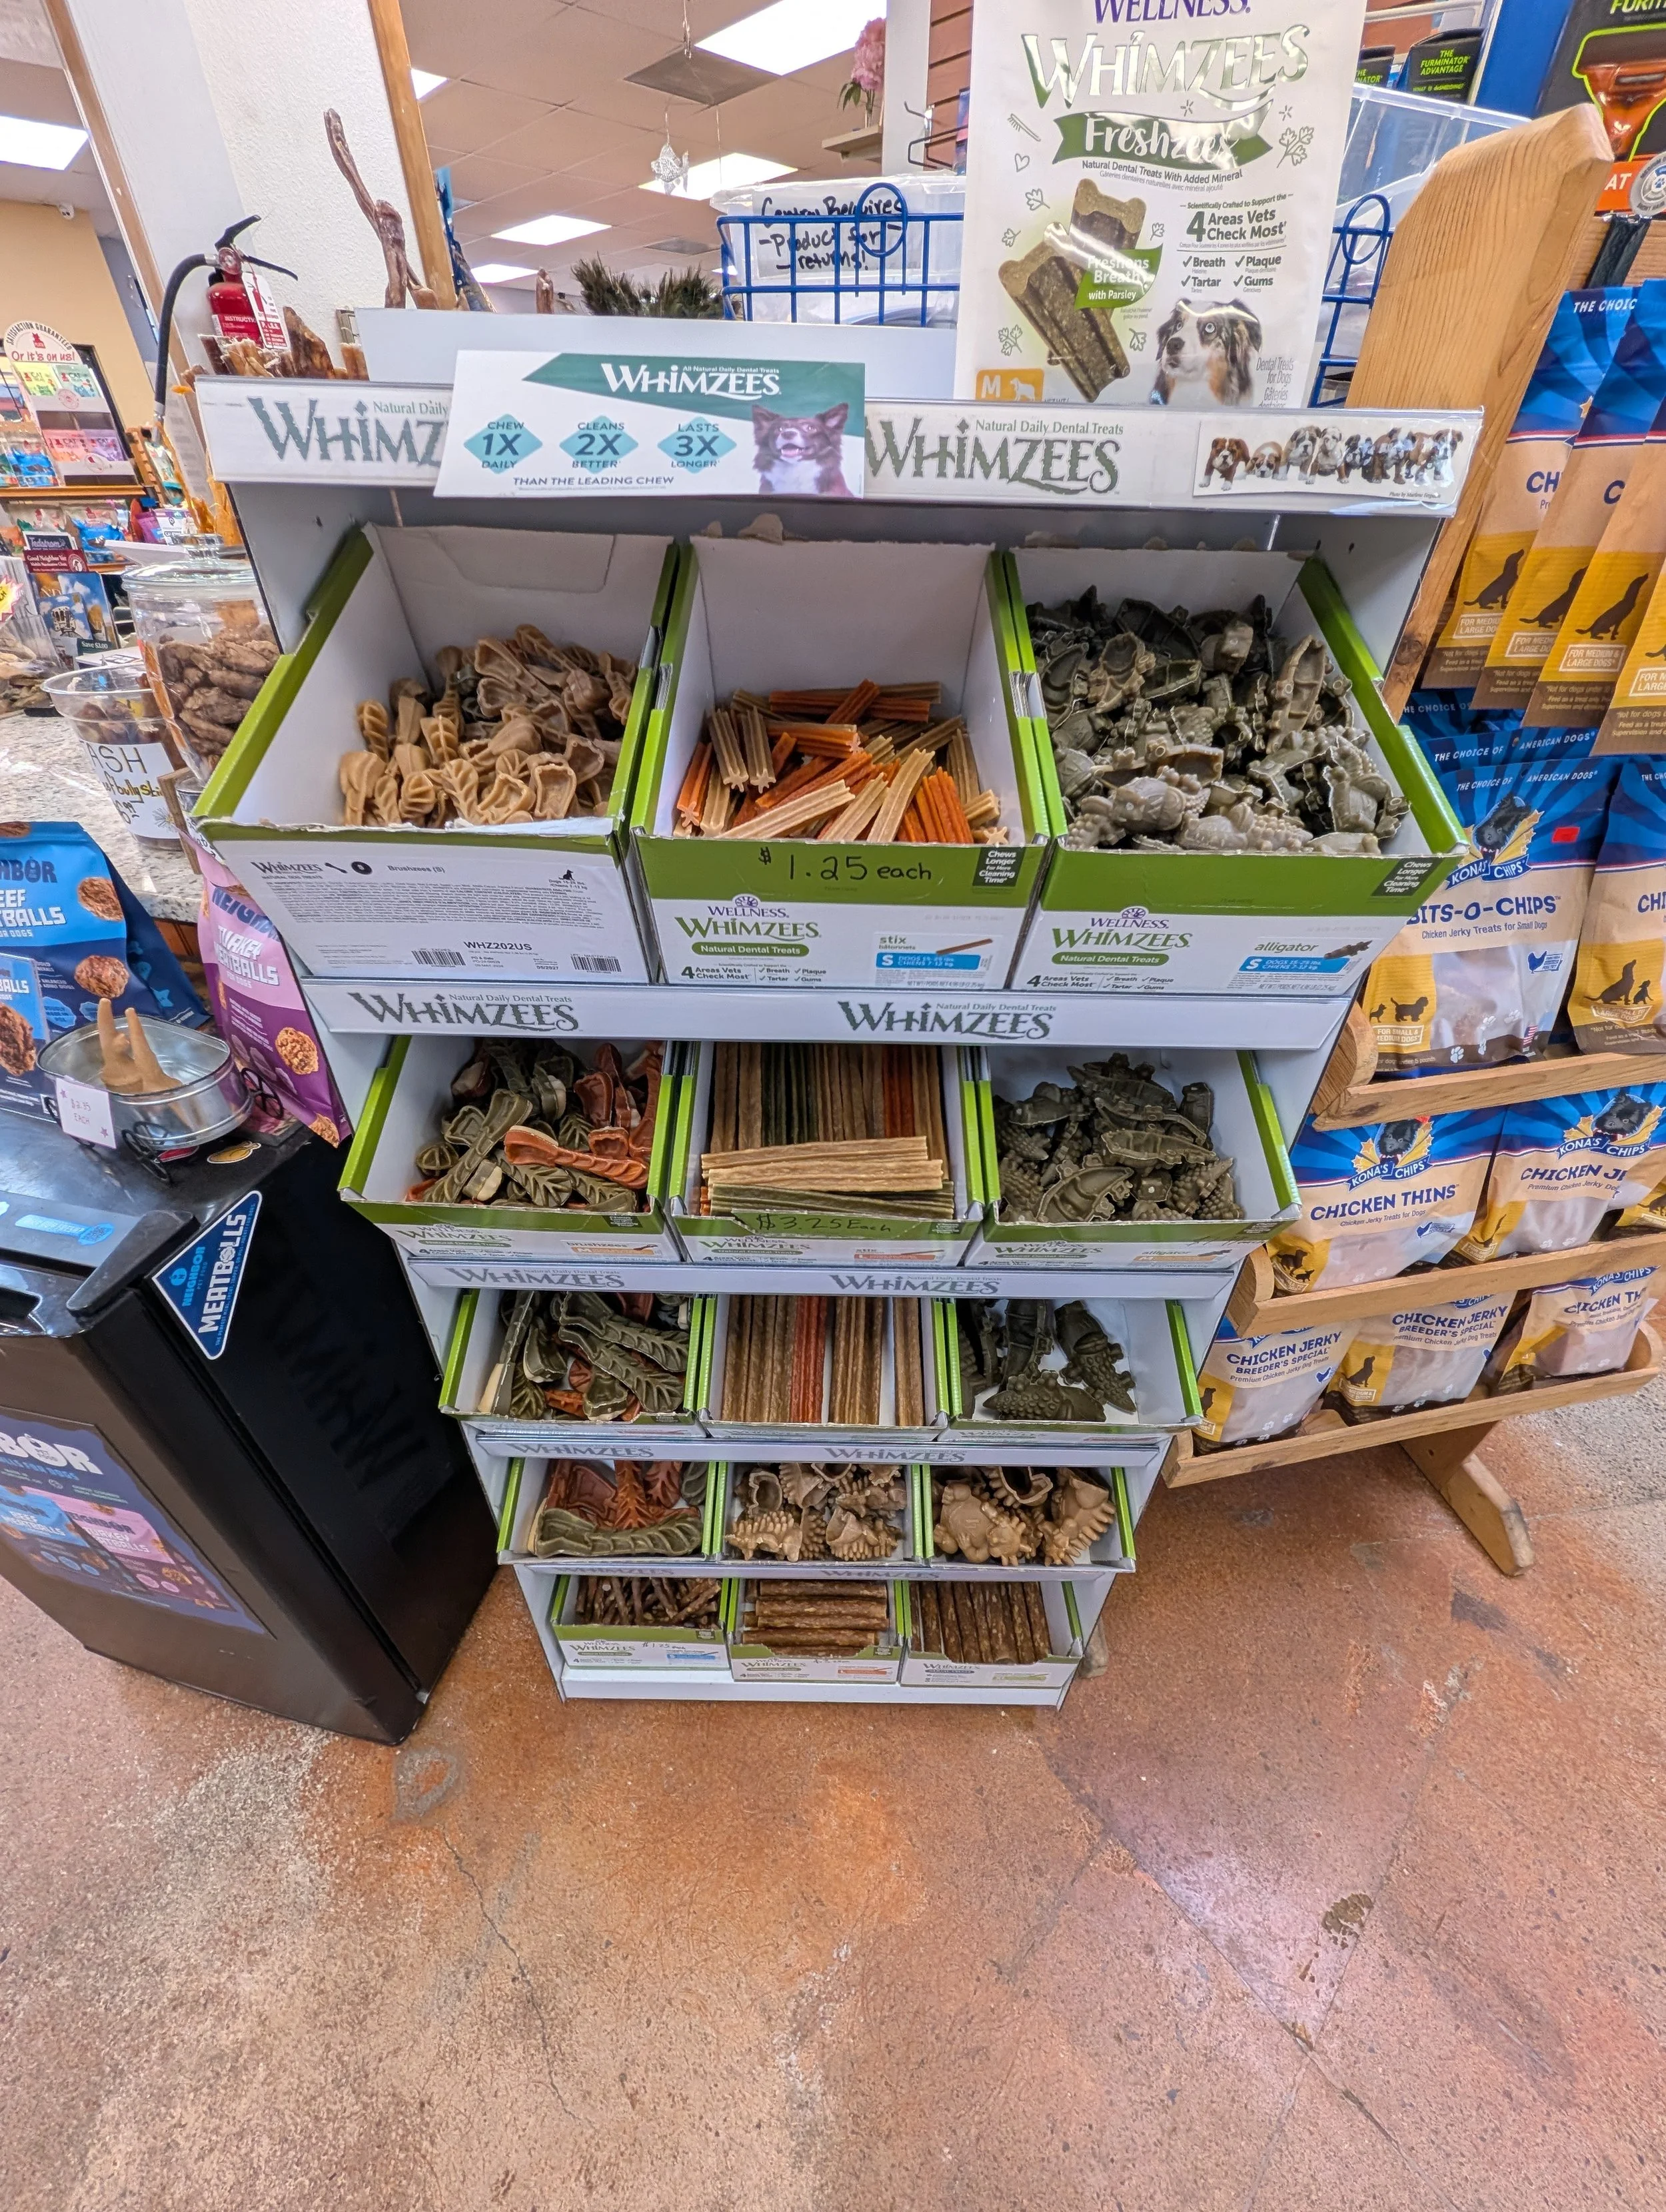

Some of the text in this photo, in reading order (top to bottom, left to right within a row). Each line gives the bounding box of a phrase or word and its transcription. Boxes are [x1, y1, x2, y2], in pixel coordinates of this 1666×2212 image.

[1440, 49, 1455, 58] THE
[1021, 24, 1311, 111] WHIMZEES
[1420, 65, 1464, 76] ADVANTAGE
[1084, 117, 1239, 165] Freshzees
[1082, 160, 1244, 184] Natural Dental Treats With Added Mineral
[1186, 211, 1206, 243] 4
[1207, 212, 1244, 226] Areas
[1247, 208, 1277, 225] Vets
[1207, 227, 1247, 241] Check
[1193, 255, 1281, 269] Breath Plaque
[1192, 275, 1273, 287] Tartar Gums
[1088, 289, 1137, 301] with Parsley
[1573, 300, 1594, 314] THE
[11, 350, 25, 361] Or
[600, 363, 780, 400] WHIMZEES
[981, 374, 1000, 398] M
[373, 400, 448, 417] Natural Daily
[247, 395, 448, 468] WHIMZ
[487, 422, 720, 432] CHEW CLEANS LASTS
[976, 419, 1124, 435] Natural Daily Dental Treats
[482, 433, 720, 457] 1X 2X 3X
[865, 416, 1122, 495] WHIMZEES
[481, 460, 518, 469] DAILY
[513, 476, 675, 486] THAN THE LEADING CHEW
[1639, 672, 1658, 682] FOR
[1418, 702, 1457, 714] CHOICE
[1434, 736, 1562, 763] THE CHOICE OF AMERICAN
[86, 742, 148, 774] ASH
[1457, 772, 1569, 792] THE CHOICE AMERICAN
[985, 857, 1016, 866] Longer
[988, 849, 1017, 858] Chews
[758, 847, 933, 881] $1.25 each
[978, 869, 1016, 879] Cleaning
[707, 905, 787, 918] WELLNESS
[674, 916, 820, 942] WHIMZEES
[1090, 917, 1168, 929] WELLNESS
[1421, 921, 1548, 939] Chicken Jerky Treats for Small Dogs
[463, 941, 532, 951] WHZ202US
[880, 935, 907, 944] stix
[1052, 927, 1193, 952] WHIMZEES
[1254, 941, 1319, 953] alligator
[700, 945, 800, 955] Natural Dental Treats
[882, 954, 894, 966] S
[1246, 958, 1263, 969] S
[681, 966, 695, 979] 4
[1026, 975, 1042, 987] 4
[486, 994, 510, 1003] Daily
[936, 1002, 970, 1011] Natural
[972, 1003, 996, 1011] Daily
[347, 992, 580, 1032] WHIMZEES
[837, 1001, 1054, 1040] WHIMZEES
[1559, 1137, 1646, 1157] KONA'S CHIPS
[1351, 1161, 1425, 1187] KONA'S CHIPS
[1520, 1164, 1603, 1181] CHICKEN
[1527, 1180, 1603, 1191] Premium Jerky
[1310, 1183, 1456, 1221] CHICKEN THINS
[757, 1213, 842, 1231] $3.25
[1340, 1219, 1365, 1227] Chicken
[1365, 1216, 1383, 1225] Jerky
[1411, 1209, 1426, 1218] Dogs
[446, 1268, 625, 1288] WHIMZEES
[829, 1274, 1001, 1295] WHIMZEES
[1391, 1305, 1508, 1329] CHICKEN JERKY
[1399, 1325, 1459, 1338] BREEDER'S
[1226, 1331, 1343, 1366] CHICKEN JERKY
[1236, 1349, 1328, 1375] BREEDER'S SPECIAL
[1230, 1361, 1313, 1383] Premium Chicken Dog
